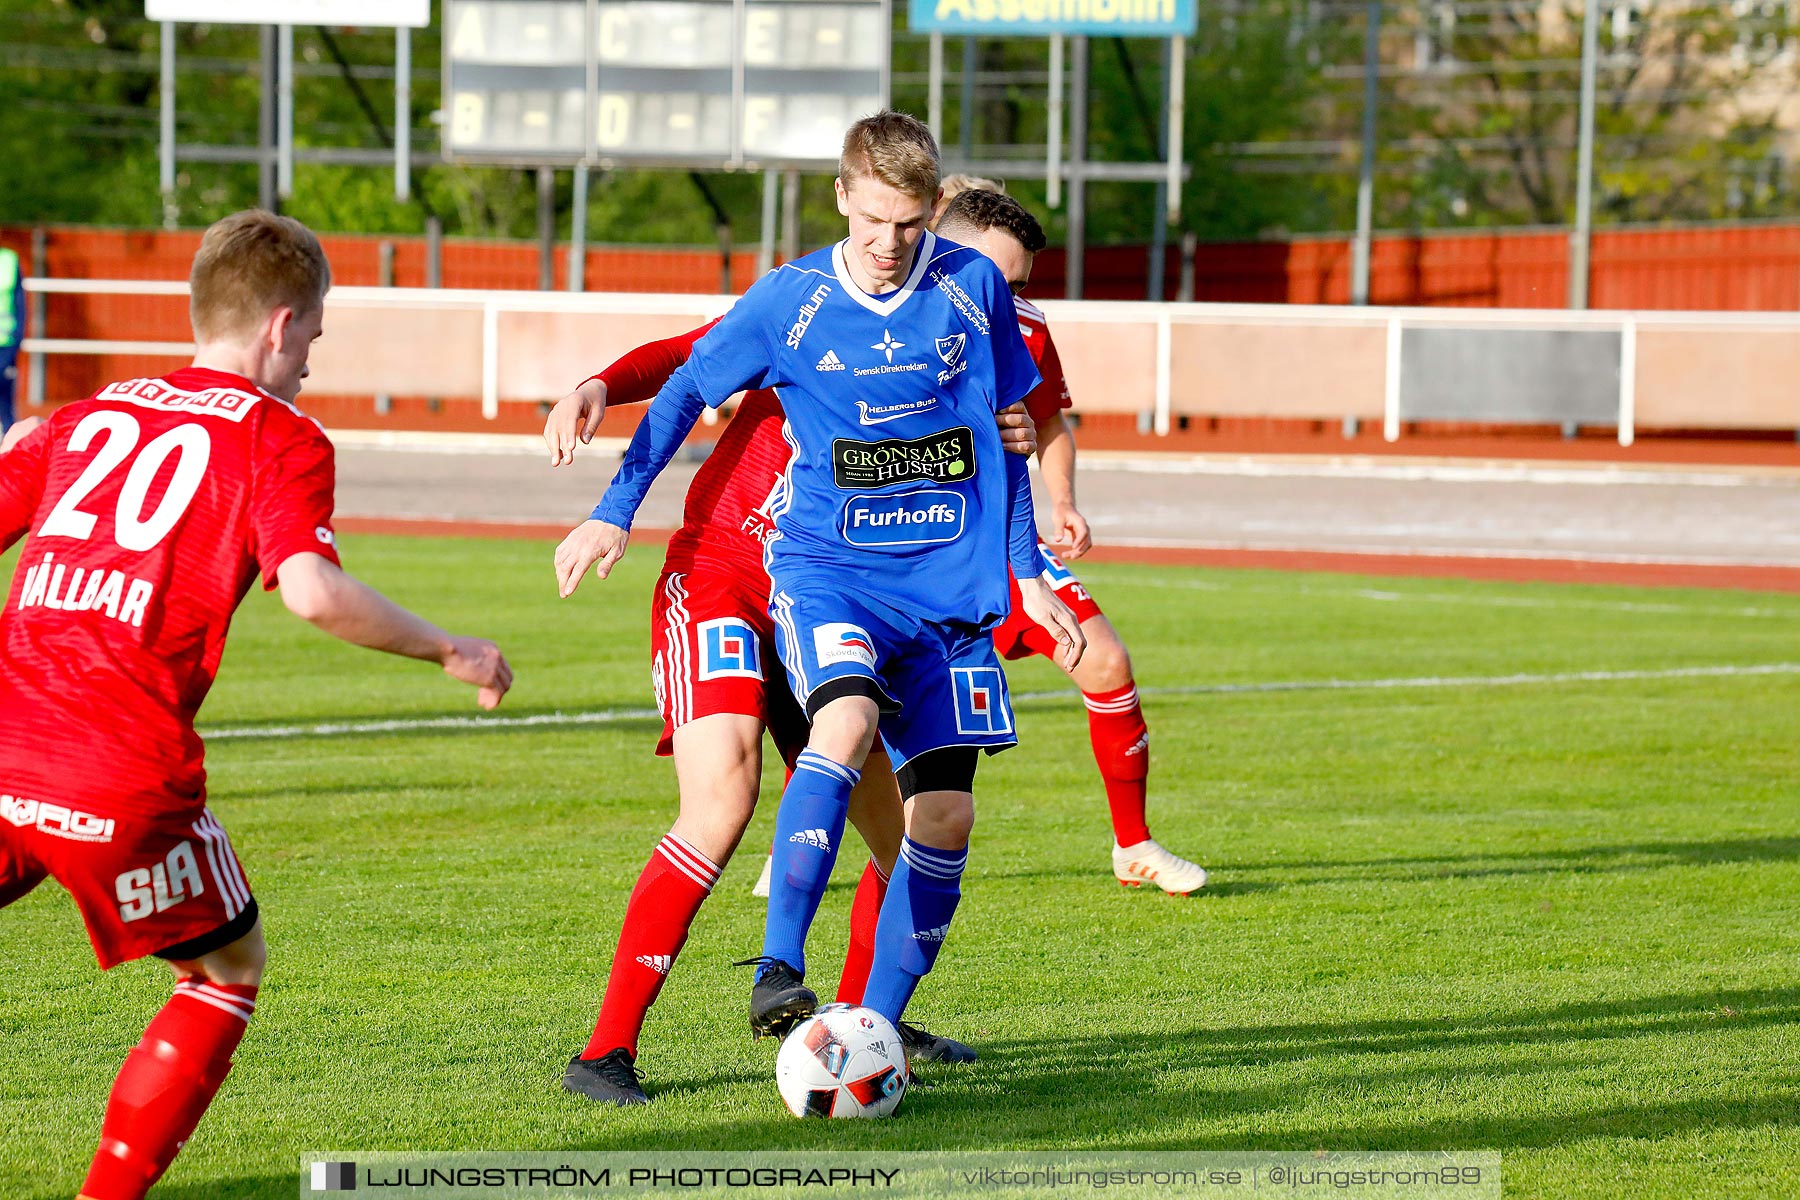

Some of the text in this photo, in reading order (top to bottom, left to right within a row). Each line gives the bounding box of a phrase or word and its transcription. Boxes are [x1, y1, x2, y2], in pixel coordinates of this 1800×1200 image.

[452, 5, 486, 58] A
[746, 9, 778, 63] E
[786, 284, 832, 351] stadium
[929, 271, 990, 335] PHOTOGRAPHY
[853, 363, 928, 377] Svensk Direktreklam
[843, 437, 961, 467] GRÖNSAKS
[876, 460, 949, 481] HUSET
[37, 410, 211, 551] 20
[853, 503, 956, 527] Furhoffs
[115, 841, 204, 923] SLA
[866, 1044, 889, 1060] adidas
